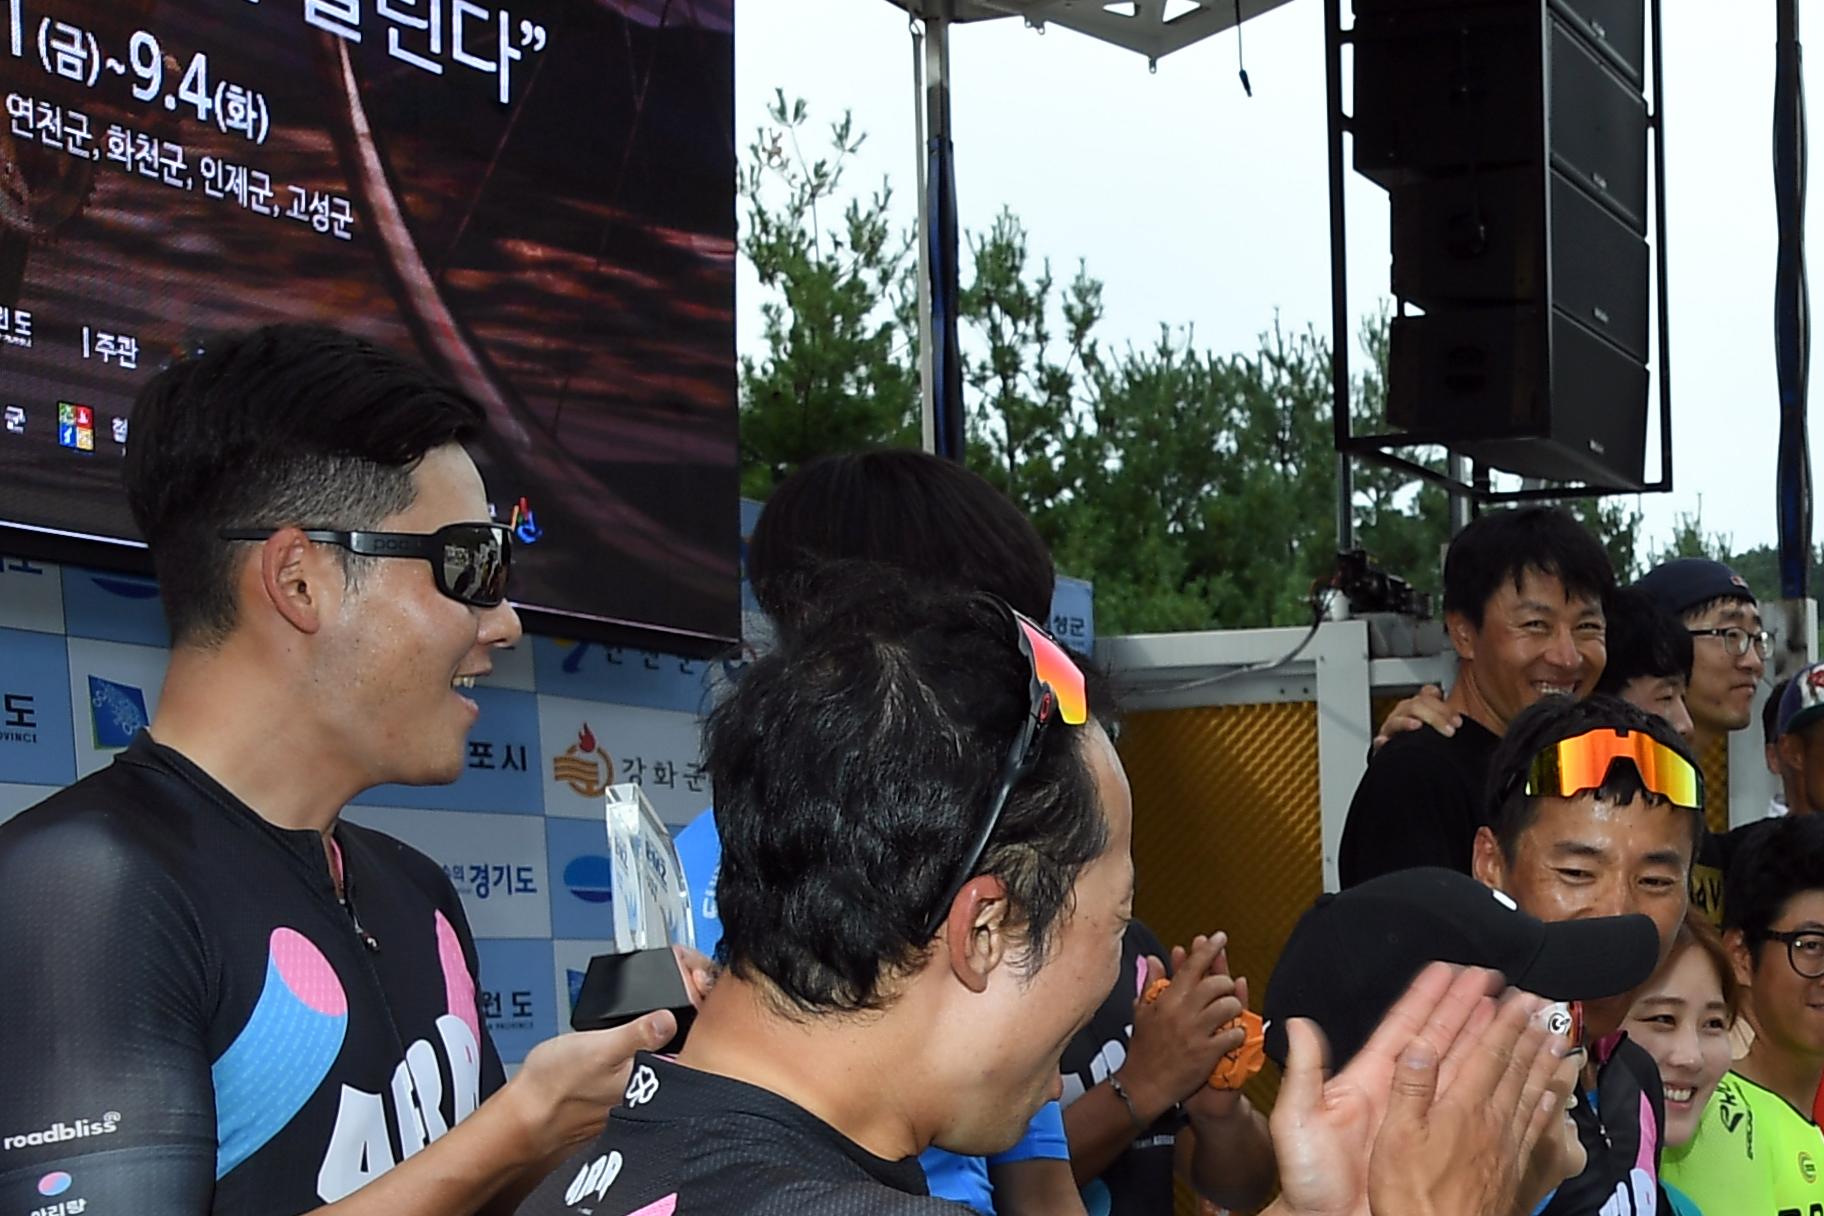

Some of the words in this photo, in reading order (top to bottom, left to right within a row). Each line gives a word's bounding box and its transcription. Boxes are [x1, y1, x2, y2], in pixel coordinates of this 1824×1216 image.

[6, 93, 100, 161] 연천군,
[105, 124, 192, 190] 화천군,
[199, 156, 279, 218] 인제군,
[286, 186, 354, 240] 고성군
[469, 864, 538, 899] 경기도
